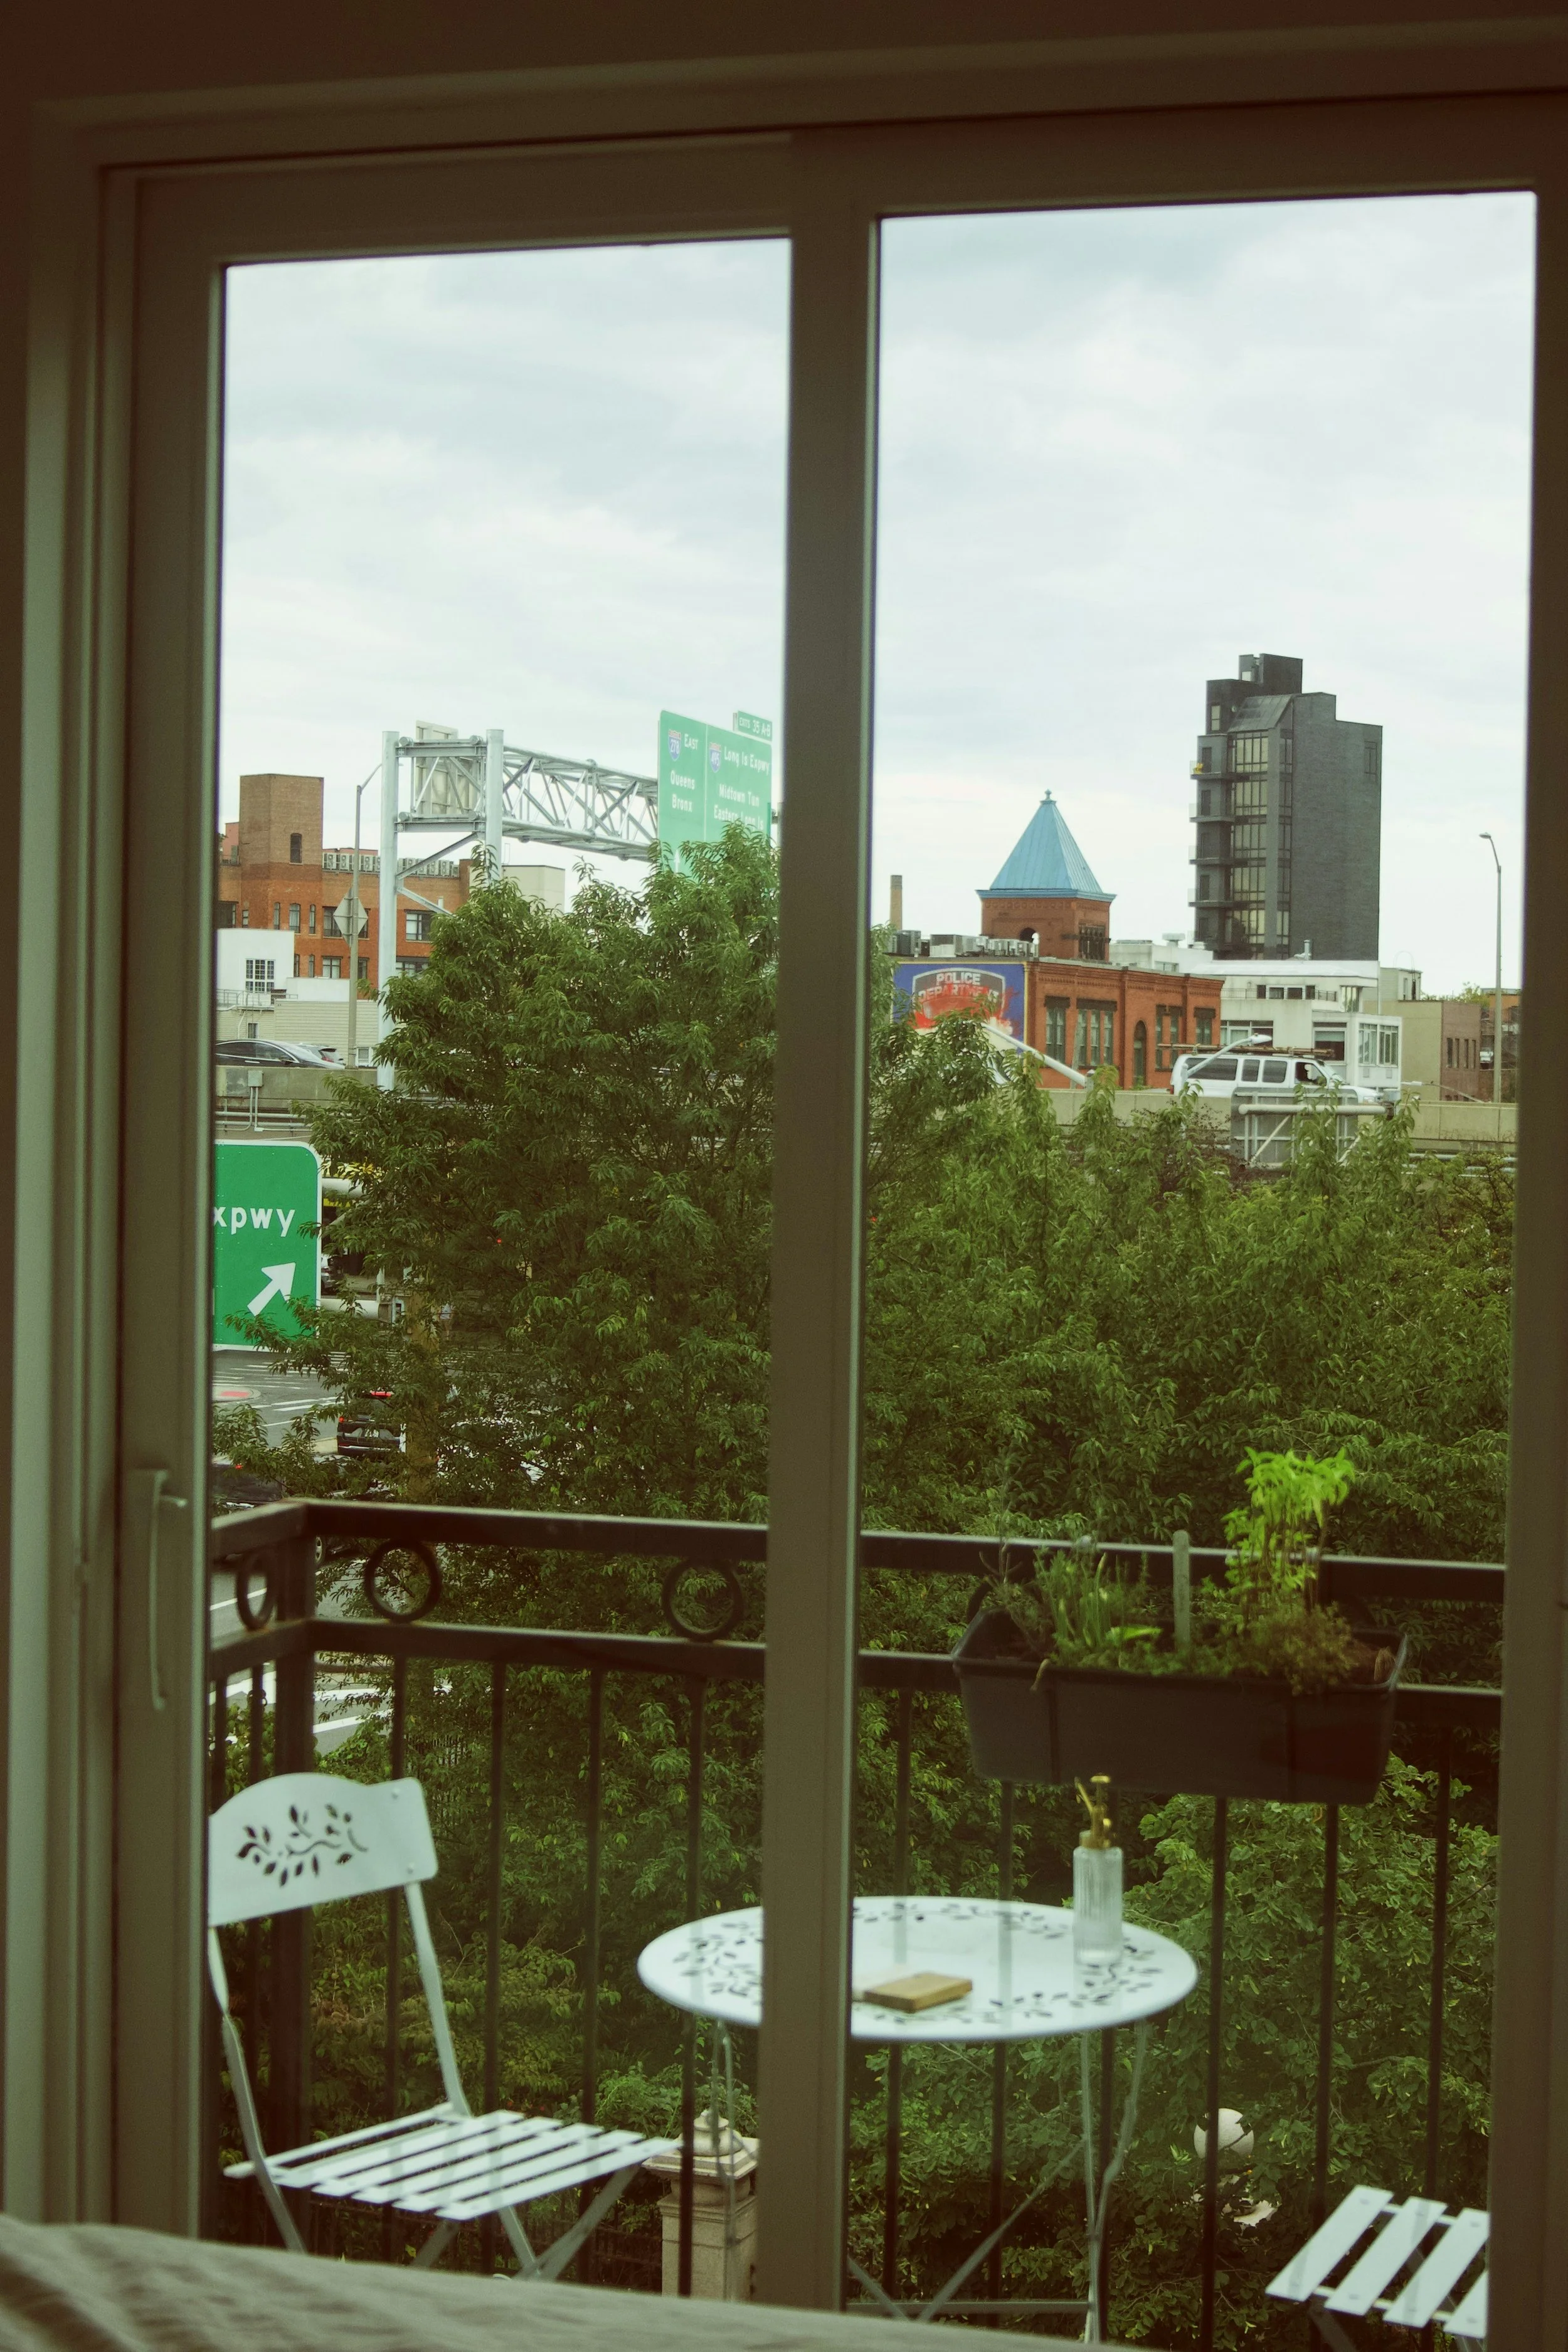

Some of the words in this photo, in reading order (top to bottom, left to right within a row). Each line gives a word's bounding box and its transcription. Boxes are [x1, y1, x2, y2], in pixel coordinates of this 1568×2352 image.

[753, 719, 760, 734] 35
[670, 739, 680, 755] 278
[711, 751, 719, 766] 495
[724, 745, 739, 768] Long
[742, 751, 748, 766] Is
[750, 754, 770, 776] Expwy
[670, 770, 695, 790] Queens
[672, 793, 692, 813] Bronx
[719, 783, 745, 803] Midtown
[748, 791, 760, 808] Tun
[758, 816, 764, 830] Is
[936, 972, 981, 985] POLICE
[214, 1206, 295, 1237] xpwy
